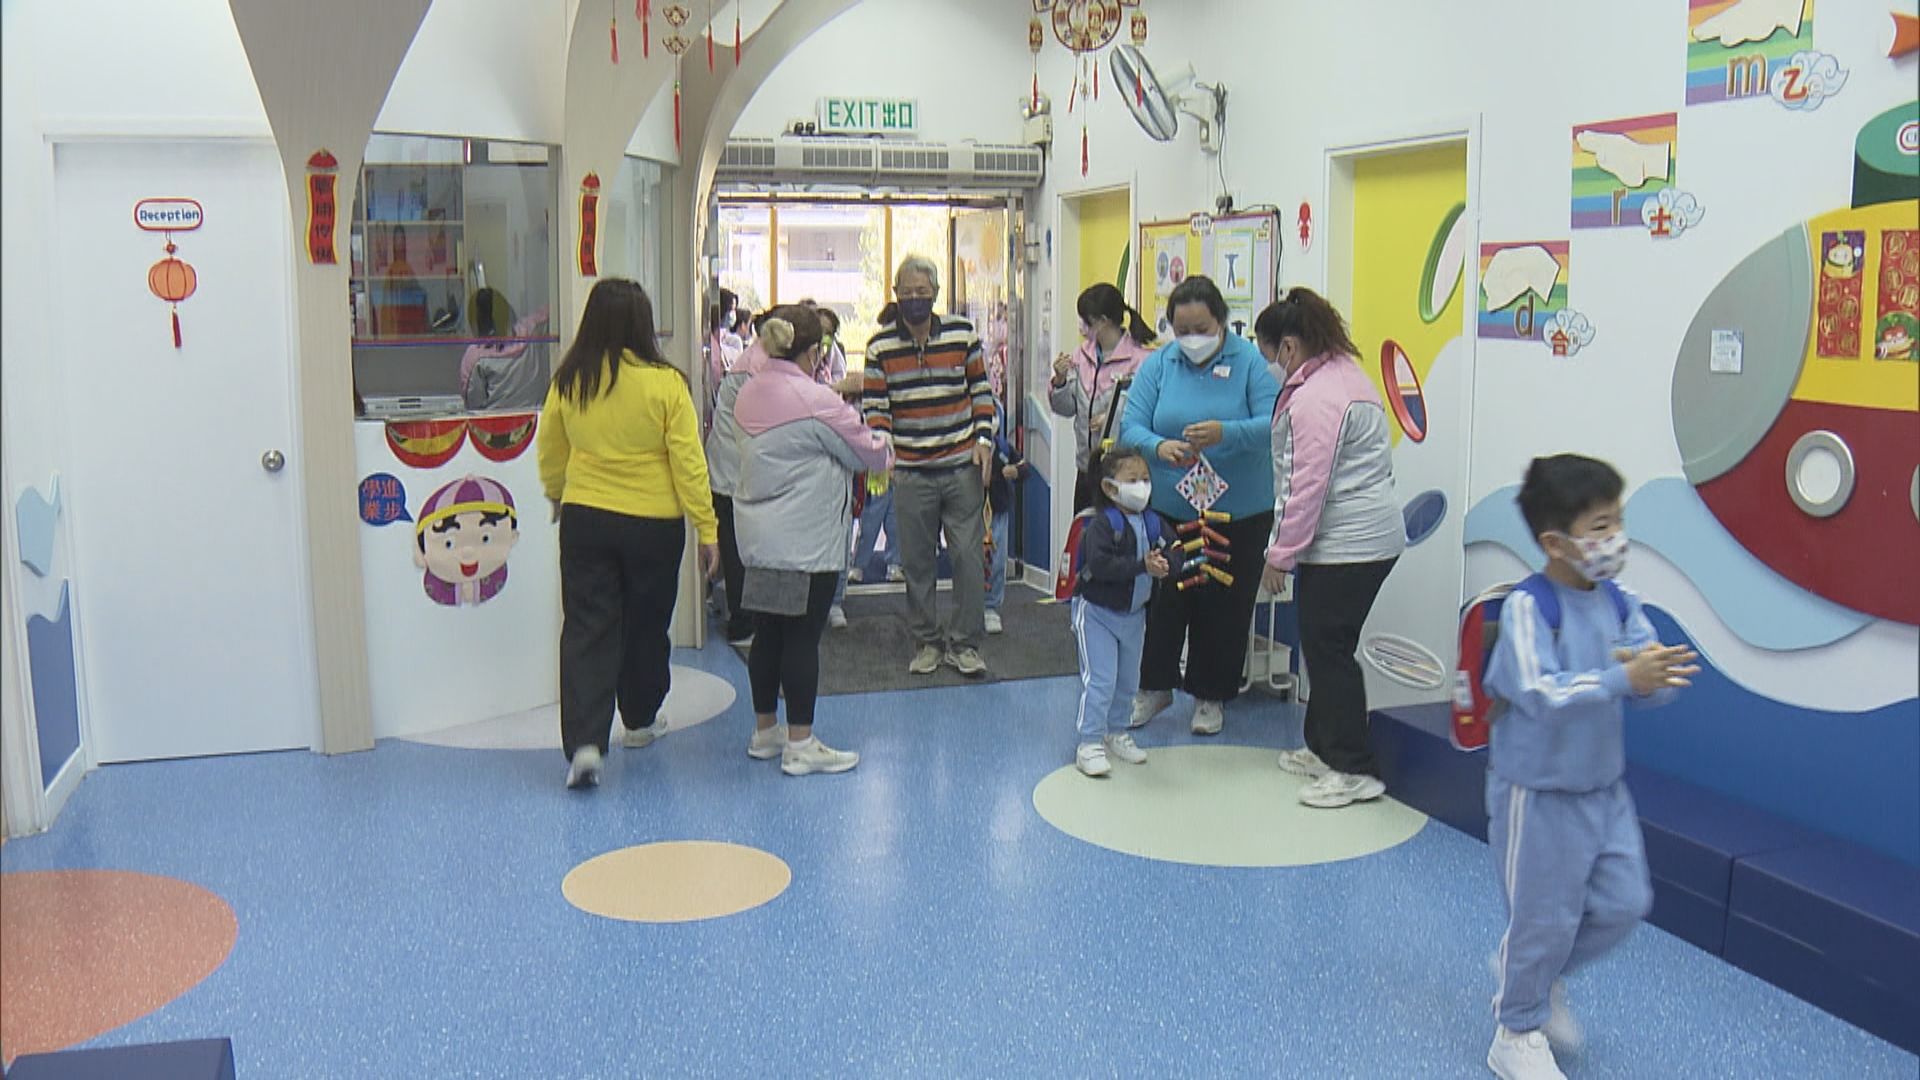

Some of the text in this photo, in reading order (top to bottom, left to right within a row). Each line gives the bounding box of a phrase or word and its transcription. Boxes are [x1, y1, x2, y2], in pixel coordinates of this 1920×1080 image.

[1728, 53, 1767, 95] m
[829, 101, 913, 128] EXIT 出口
[139, 208, 200, 222] Reception
[1514, 294, 1534, 337] d
